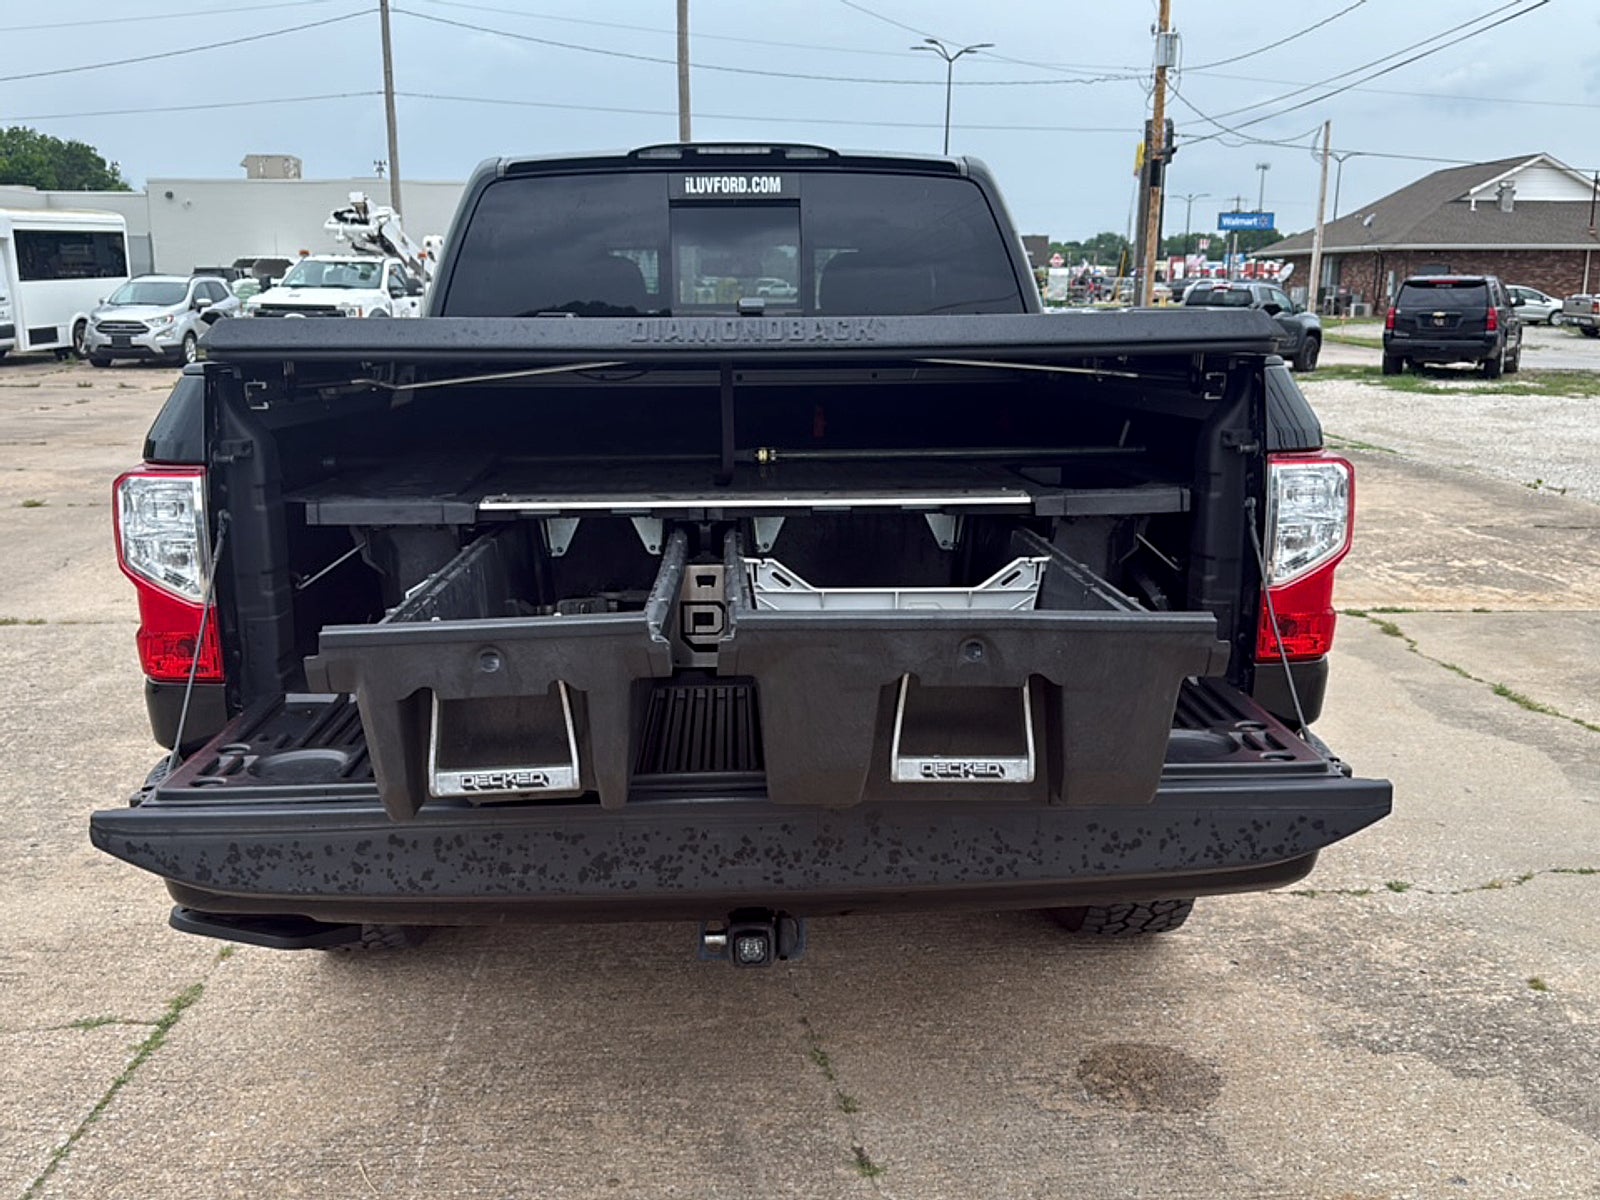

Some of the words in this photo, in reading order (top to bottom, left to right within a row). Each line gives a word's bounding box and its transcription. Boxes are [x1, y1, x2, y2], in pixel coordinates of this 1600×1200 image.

[684, 176, 781, 193] iLUVFORD.COM
[1222, 216, 1258, 226] Walmart
[631, 317, 877, 343] DIAMONDBACK
[919, 762, 1006, 778] DECKED
[460, 772, 550, 791] DECKED
